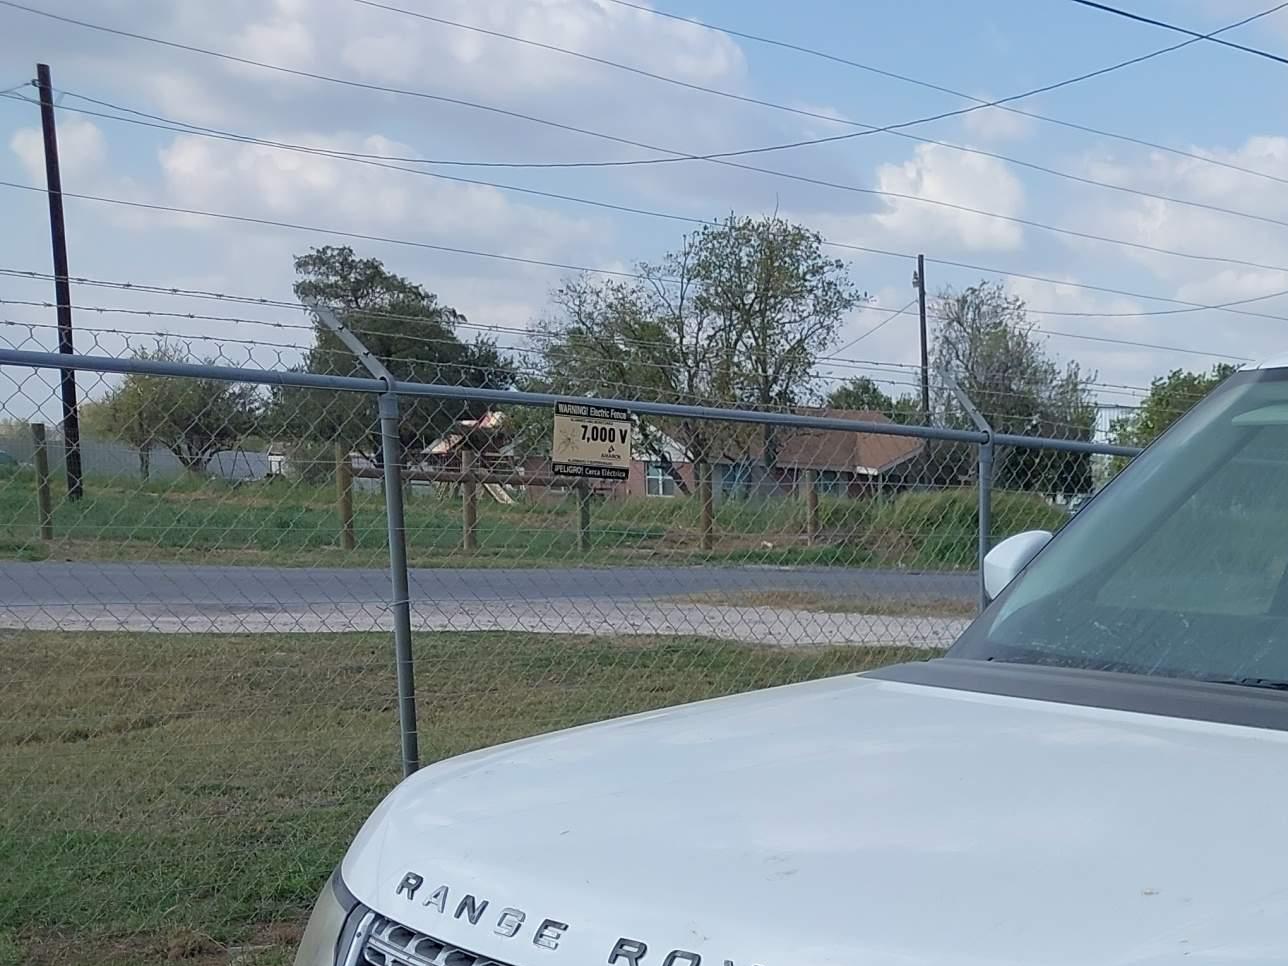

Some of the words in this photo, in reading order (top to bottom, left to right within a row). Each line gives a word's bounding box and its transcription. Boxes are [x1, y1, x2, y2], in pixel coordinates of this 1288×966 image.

[558, 403, 589, 417] WARNING!
[590, 407, 610, 418] Electric
[610, 409, 627, 420] Fence
[581, 425, 616, 443] 7,000
[619, 428, 628, 444] V
[584, 468, 601, 476] Cerca
[601, 468, 626, 477] Eléctrica
[395, 871, 569, 951] RANGE
